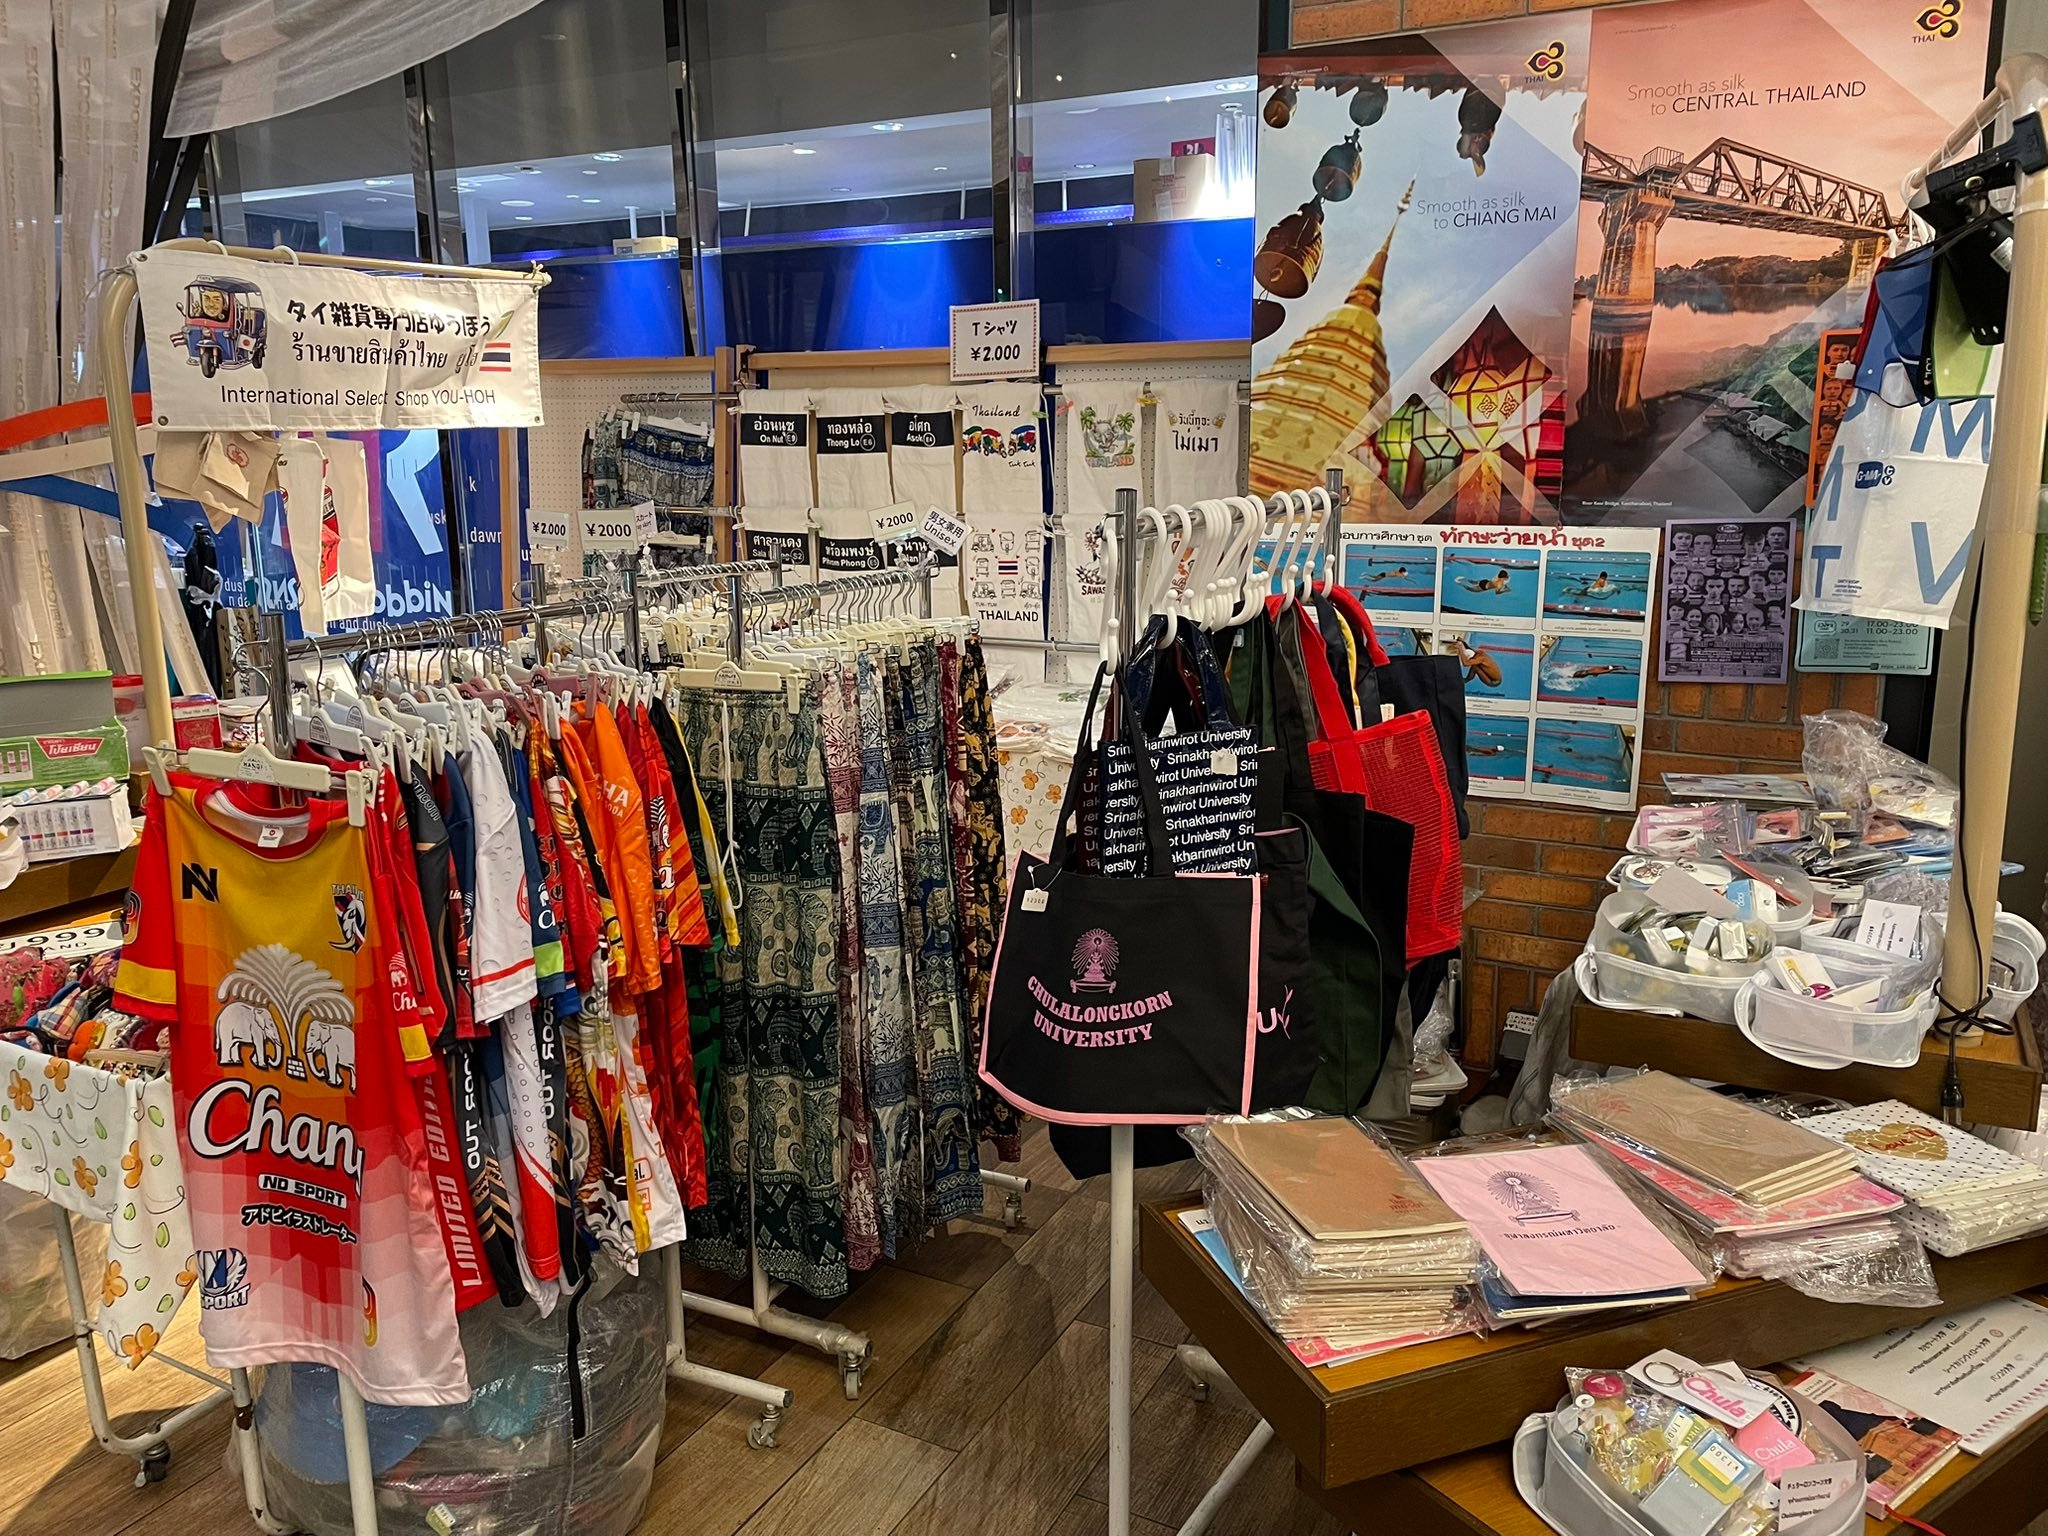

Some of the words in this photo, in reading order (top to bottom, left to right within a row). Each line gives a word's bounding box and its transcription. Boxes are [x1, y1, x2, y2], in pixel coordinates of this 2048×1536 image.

[1911, 34, 1936, 44] THAI
[1524, 75, 1546, 84] THAI
[1627, 81, 1693, 100] Smooth
[1698, 82, 1716, 94] as
[1720, 74, 1746, 92] silk
[1650, 99, 1667, 116] to
[1671, 92, 1760, 115] CENTRAL
[1765, 80, 1866, 106] THAILAND
[1417, 197, 1476, 215] Smooth
[1480, 198, 1496, 209] as
[1499, 192, 1526, 208] silk
[1433, 215, 1449, 230] to
[1453, 209, 1521, 229] CHIANG
[1525, 206, 1557, 223] MAI
[287, 299, 491, 337] タイ雑貨専門店ゆうほう
[292, 331, 447, 369] ร้านขายสินค้าไทย
[220, 385, 339, 406] International
[344, 389, 388, 406] Select
[394, 390, 429, 408] Shop
[431, 389, 496, 405] YOU-HOH
[972, 404, 1021, 418] Thailand
[908, 418, 931, 432] อโศก
[760, 434, 771, 443] On
[772, 434, 784, 443] Nut
[826, 437, 849, 449] Thong
[850, 438, 860, 447] Lo
[906, 433, 924, 443] Asok
[585, 523, 632, 537] ¥2000
[876, 511, 914, 530] ¥2000
[928, 510, 965, 540] 男女兼用
[923, 520, 957, 548] Unisex
[752, 549, 767, 558] Sala
[841, 559, 866, 568] Phong
[978, 610, 1039, 622] THAILAND
[1200, 727, 1252, 743] University
[1198, 793, 1252, 809] University
[1181, 827, 1231, 843] University
[1238, 824, 1255, 836] Sri
[1200, 857, 1252, 874] University
[1026, 975, 1174, 1024] CHULALONGKORN
[1032, 1009, 1154, 1048] UNIVERSITY
[466, 1120, 480, 1169] OUT
[294, 1182, 346, 1206] SPORT
[436, 1175, 483, 1287] LIMITED
[1684, 1376, 1748, 1419] Chula
[1754, 1438, 1798, 1462] Chula
